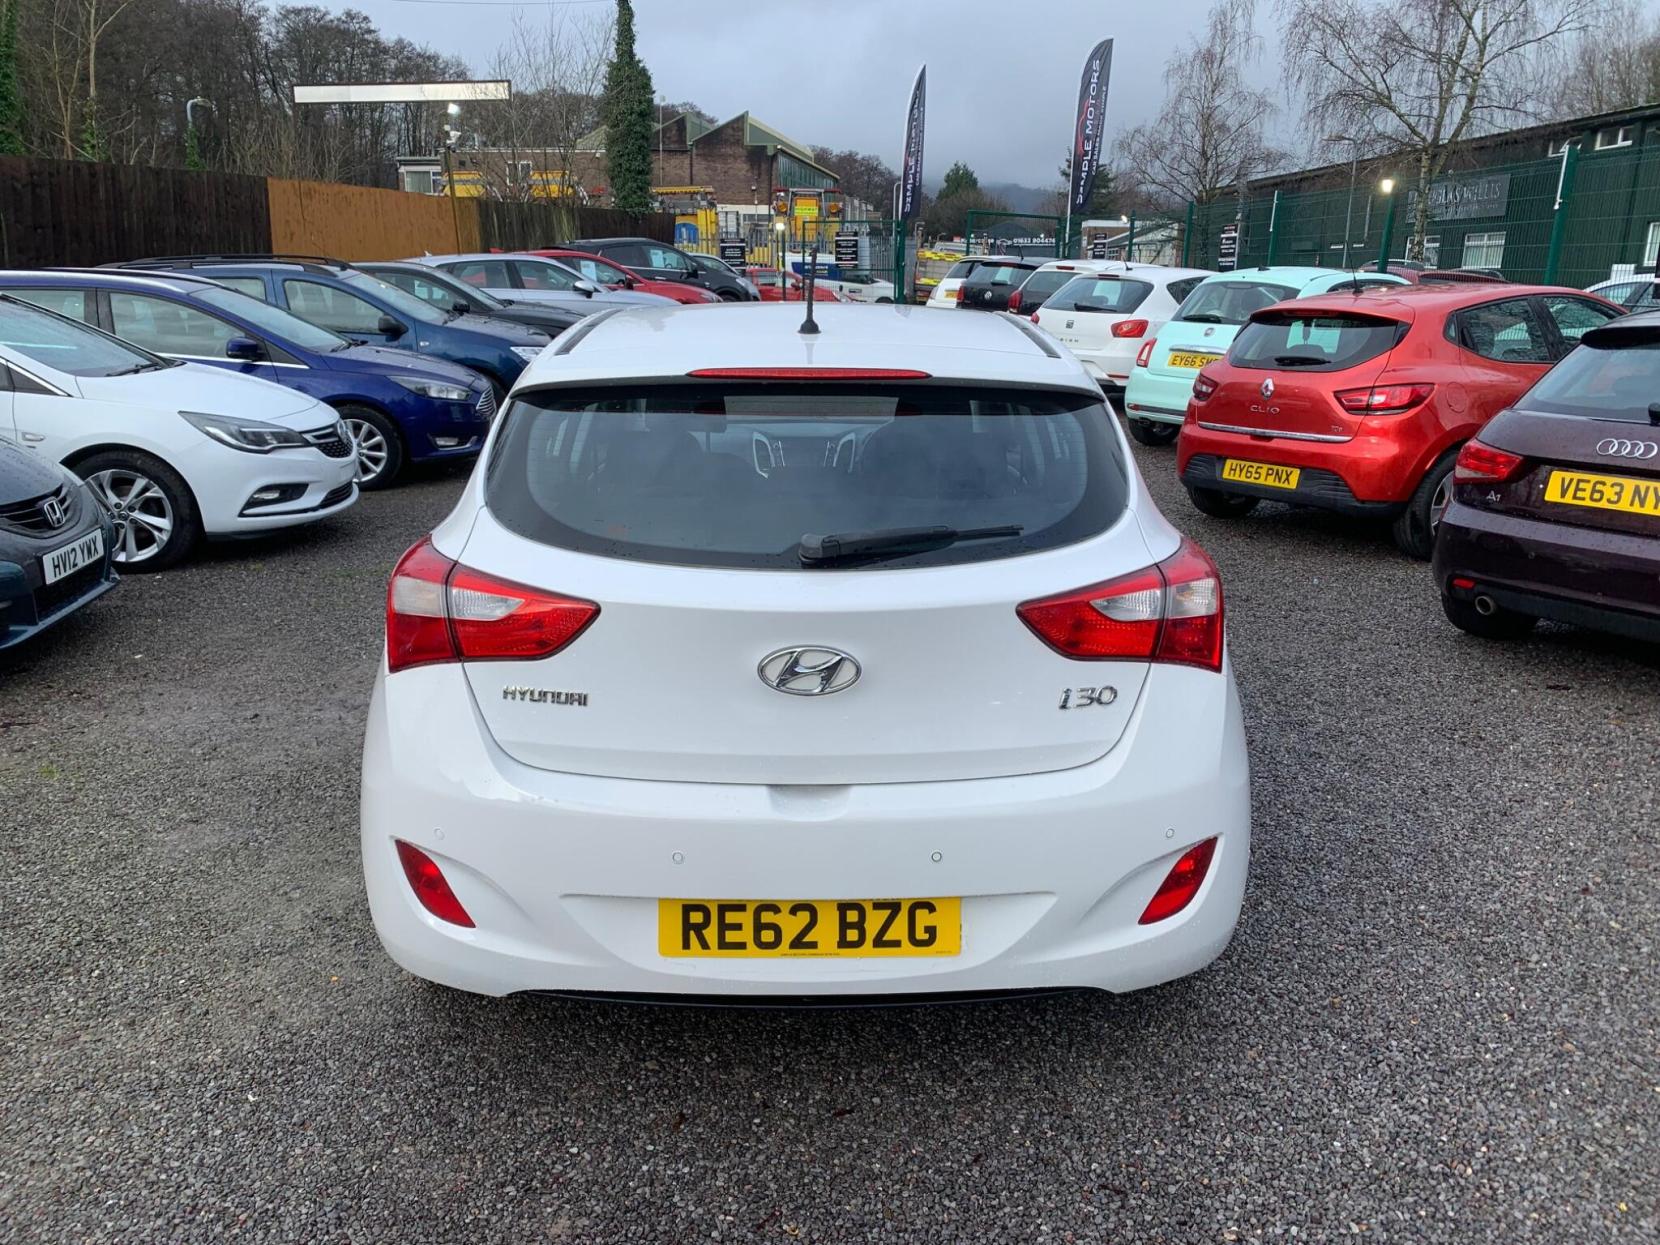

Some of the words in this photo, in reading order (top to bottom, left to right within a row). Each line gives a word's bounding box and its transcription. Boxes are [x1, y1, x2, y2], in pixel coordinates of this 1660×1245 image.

[1086, 59, 1101, 135] MOTORS
[1171, 354, 1197, 367] EY66
[1250, 404, 1280, 415] CLIO
[1228, 462, 1262, 480] HY65
[1264, 467, 1294, 485] PNX
[1486, 490, 1501, 502] A1
[1560, 477, 1625, 505] VE63
[51, 547, 78, 578] HV12
[79, 535, 99, 563] YWX
[502, 685, 588, 707] HYUNDAI
[1059, 685, 1118, 709] i30
[681, 903, 819, 950] RE62
[836, 901, 938, 949] BZG
